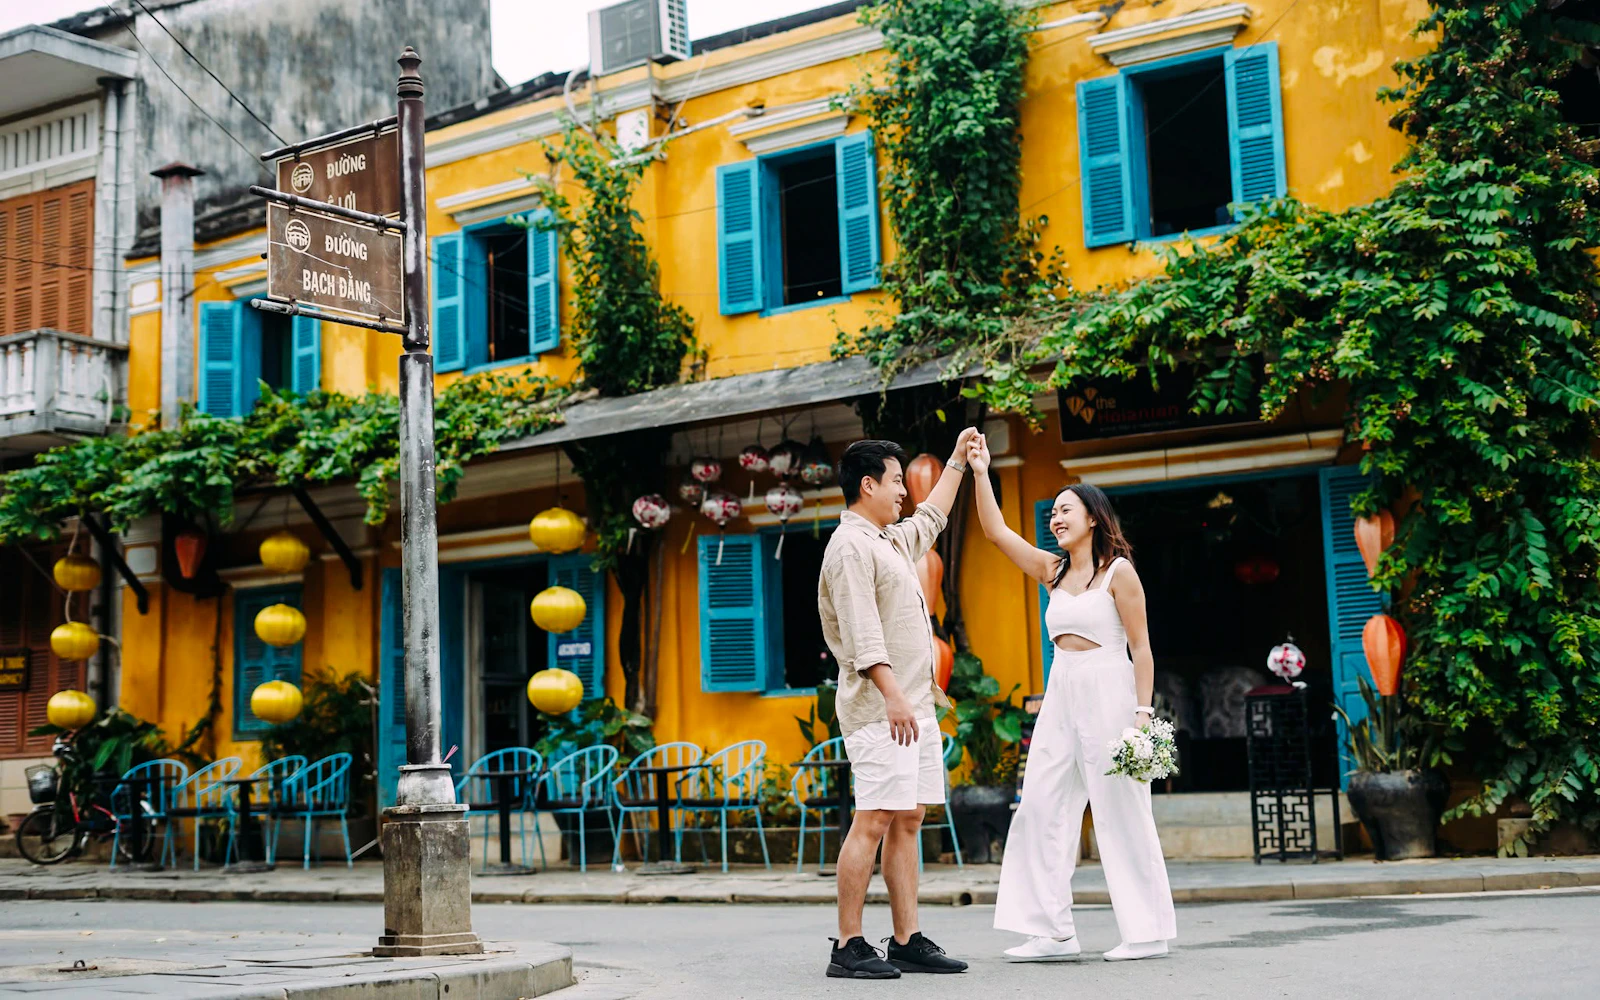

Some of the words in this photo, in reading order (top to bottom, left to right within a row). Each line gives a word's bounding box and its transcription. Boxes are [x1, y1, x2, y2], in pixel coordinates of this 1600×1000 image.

[326, 153, 366, 180] ĐƯỜNG
[325, 232, 368, 261] ĐƯỜNG
[302, 268, 336, 296] BẠCH
[338, 270, 371, 304] ĐẰNG
[1096, 396, 1117, 410] the
